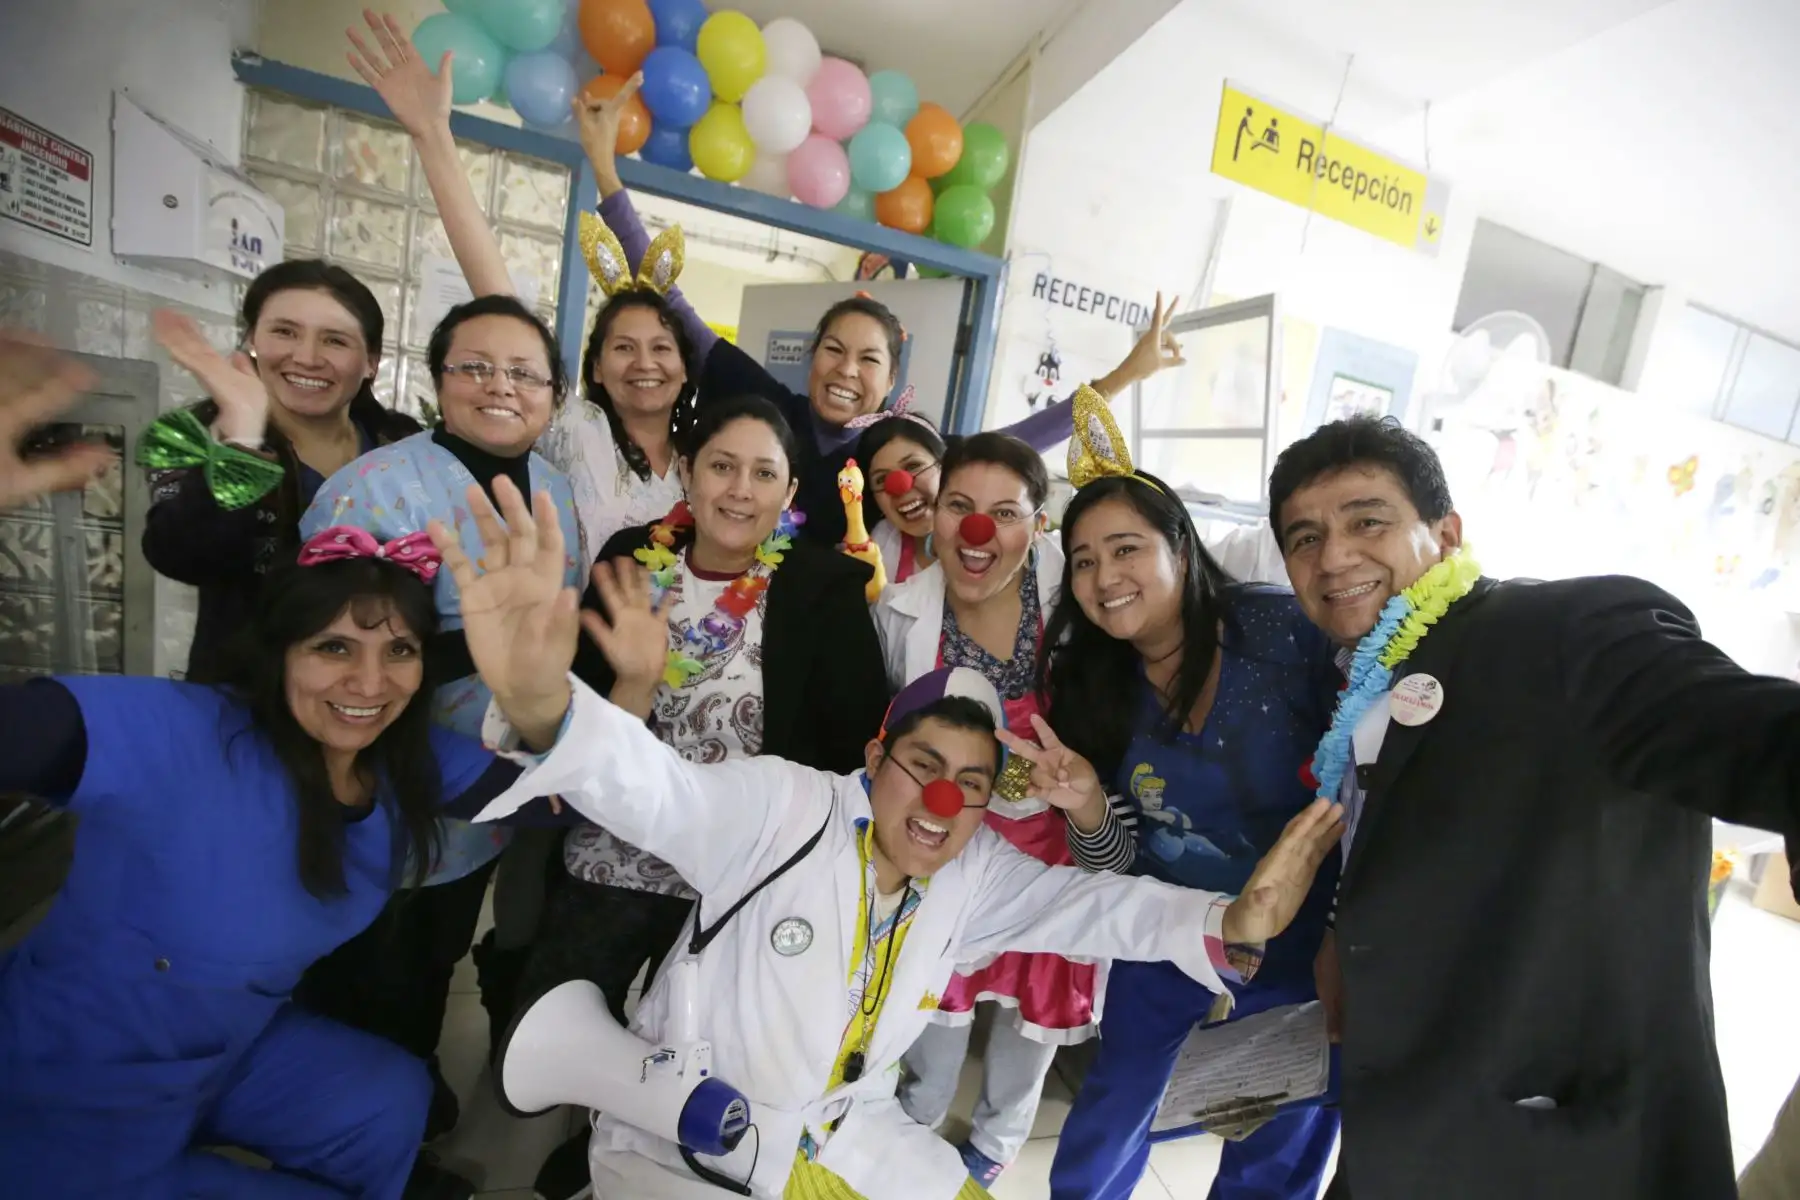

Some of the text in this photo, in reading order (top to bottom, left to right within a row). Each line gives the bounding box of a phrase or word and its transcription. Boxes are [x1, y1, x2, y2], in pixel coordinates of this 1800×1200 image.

[21, 135, 68, 170] INCENDIO
[50, 140, 87, 166] CONTRA
[1296, 138, 1412, 214] Recepción
